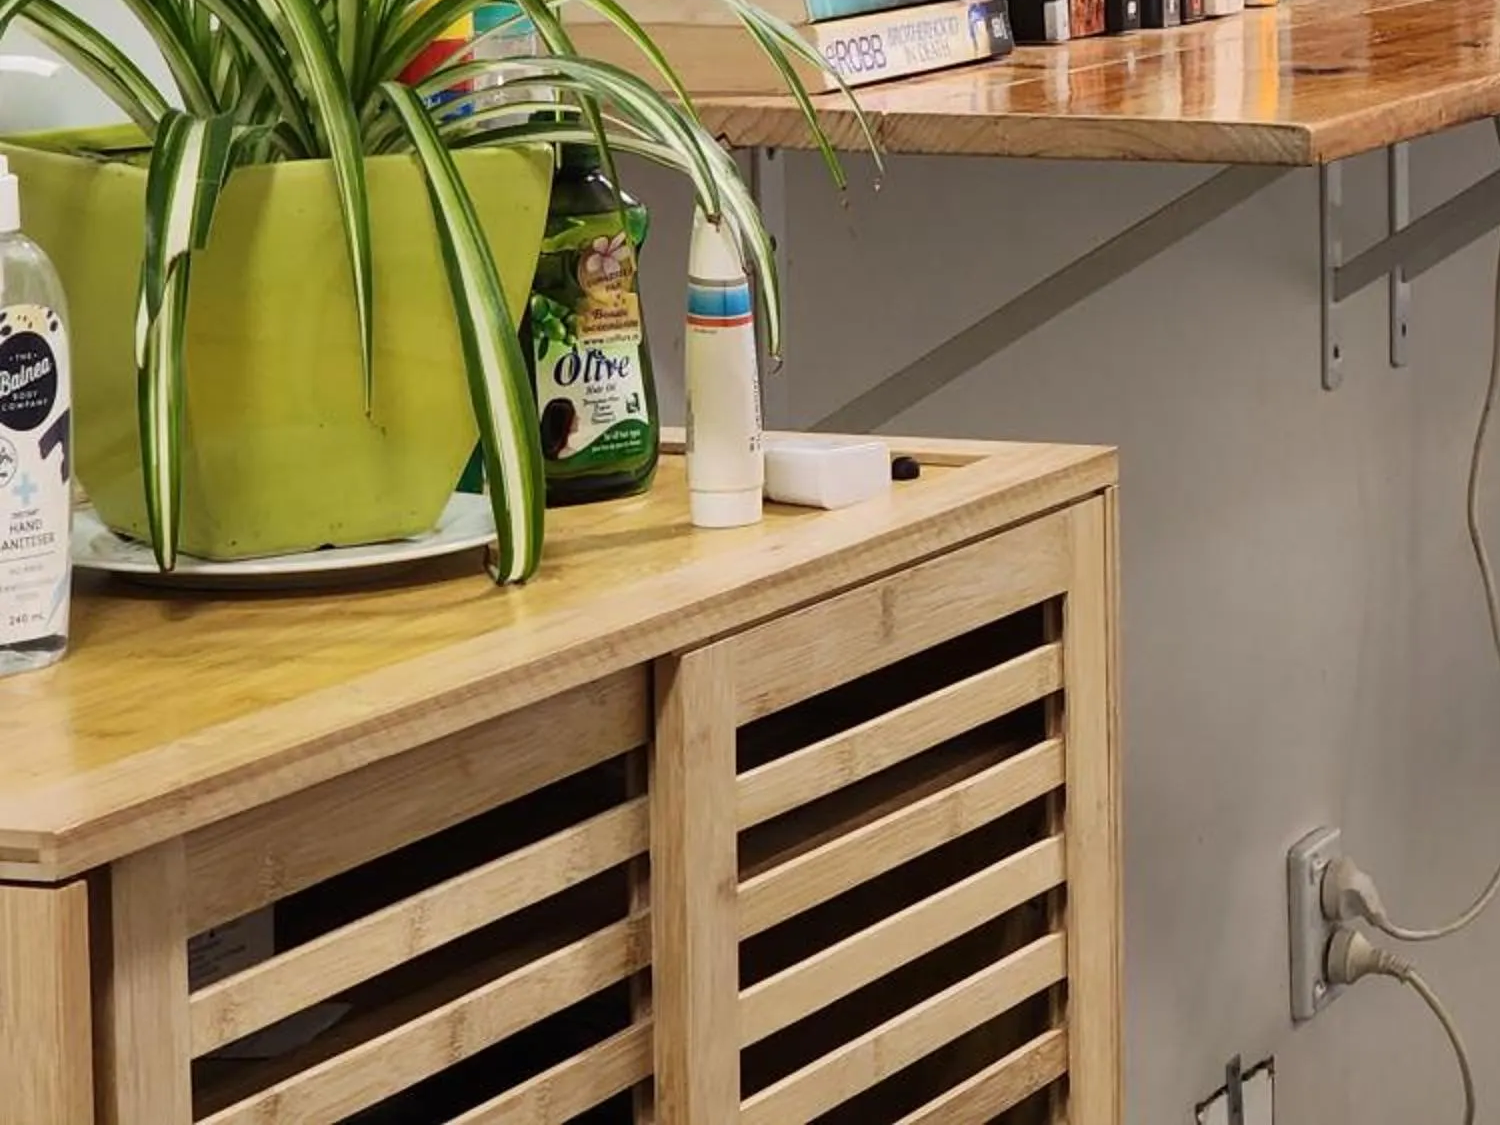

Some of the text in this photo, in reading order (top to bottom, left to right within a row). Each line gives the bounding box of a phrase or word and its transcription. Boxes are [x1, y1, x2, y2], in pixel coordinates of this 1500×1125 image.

[835, 34, 887, 75] ROBB
[15, 352, 31, 361] THE
[553, 347, 631, 387] Olive
[12, 390, 37, 401] BODY
[1, 397, 48, 412] COMPANY
[9, 518, 43, 534] HAND
[0, 531, 55, 551] ANITISER
[9, 613, 28, 627] 240
